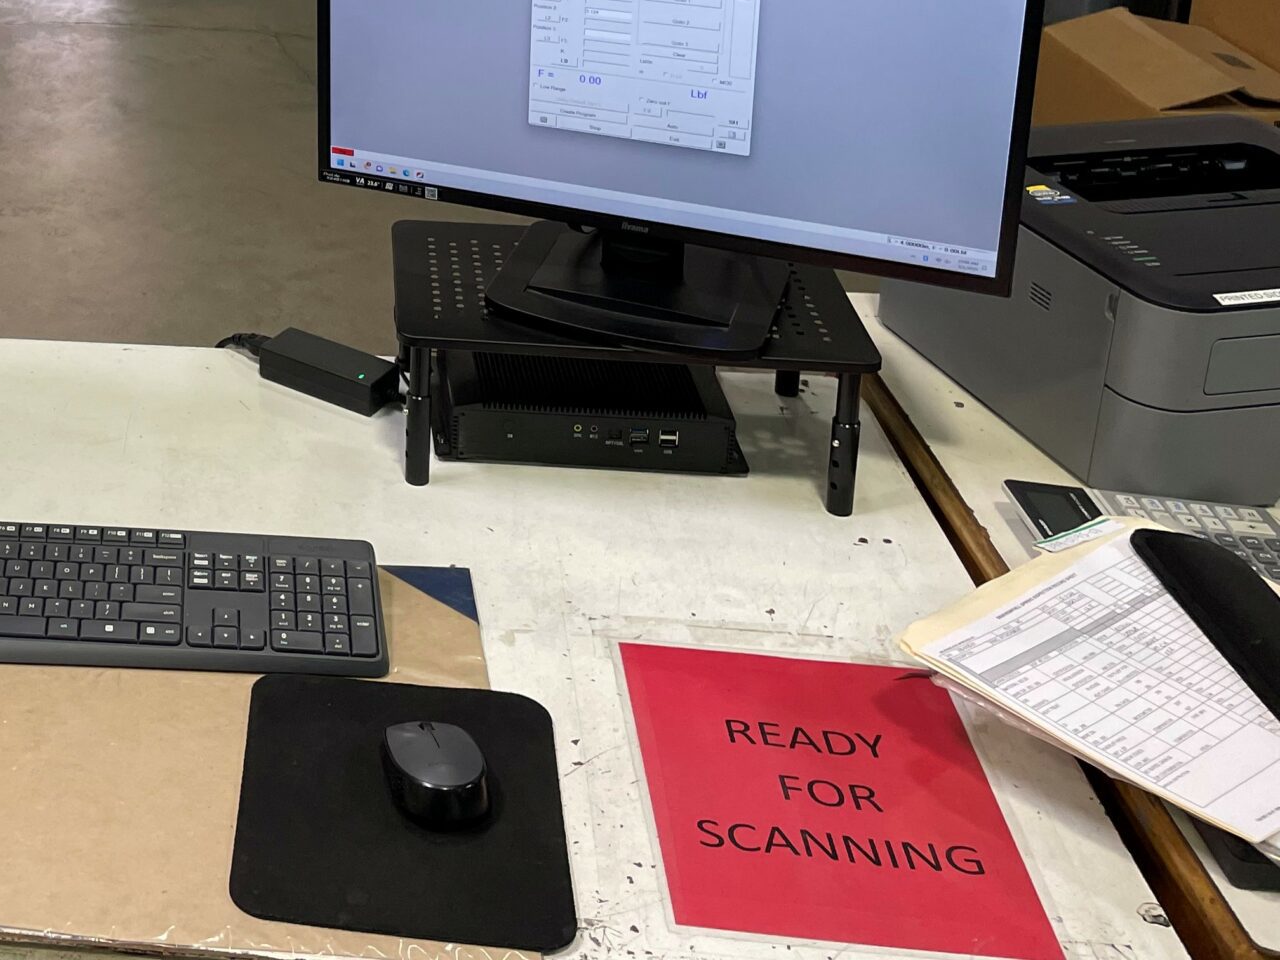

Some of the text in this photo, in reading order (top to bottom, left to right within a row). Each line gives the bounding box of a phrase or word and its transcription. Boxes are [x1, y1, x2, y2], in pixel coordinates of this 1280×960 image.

[579, 74, 602, 85] 0.00
[691, 89, 708, 99] Lbf
[1220, 291, 1263, 303] PRINTED
[724, 719, 882, 759] READY
[778, 775, 884, 813] FOR
[696, 819, 986, 876] SCANNING
